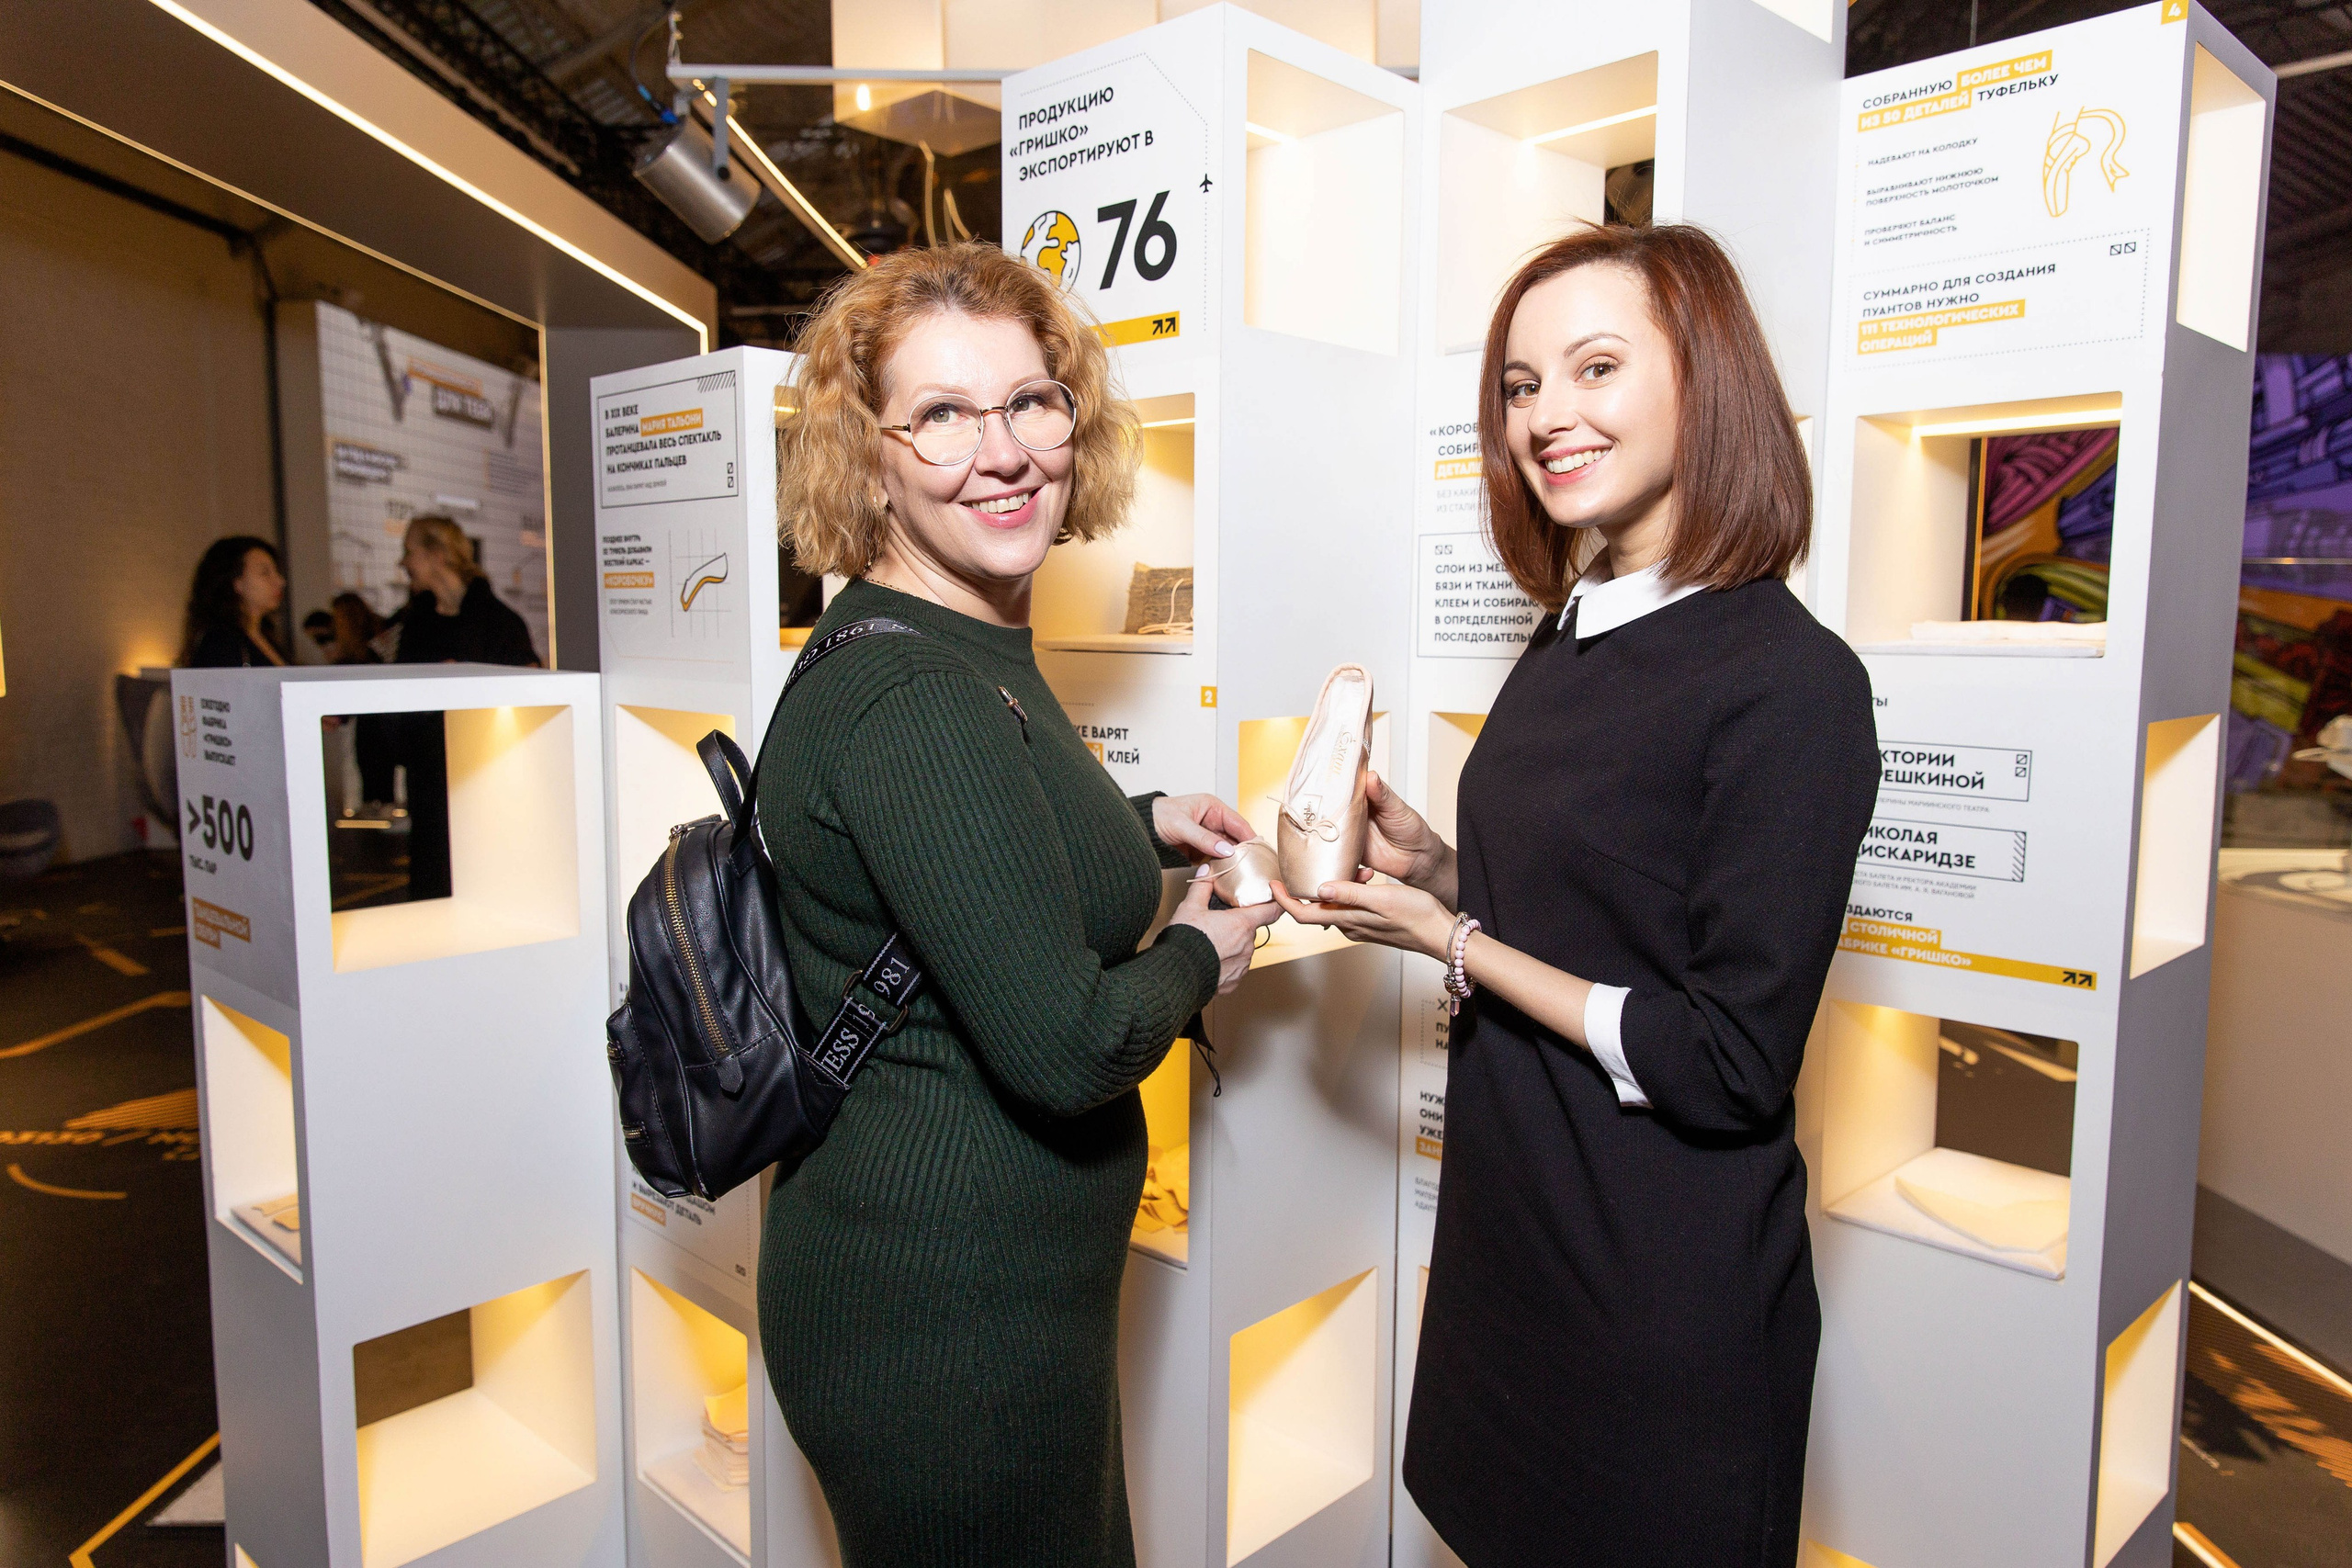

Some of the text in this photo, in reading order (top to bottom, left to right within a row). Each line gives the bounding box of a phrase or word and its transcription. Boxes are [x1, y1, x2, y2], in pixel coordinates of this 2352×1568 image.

[2168, 2, 2181, 17] 4
[1863, 56, 2048, 109] СОБРАННУЮ БОЛЕЕ ЧЕМ
[1019, 86, 1114, 130] ПРОДУКЦИЮ
[1861, 112, 1881, 129] ИЗ
[1904, 90, 1970, 121] ДЕТАЛЕЙ
[1977, 73, 2059, 101] ТУФЕЛЬКУ
[1009, 124, 1089, 158] «ГРИШКО»
[1868, 138, 1978, 166] НАДЕВАЮТ НА КОЛОДКУ
[1019, 130, 1154, 182] ЭКСПОРТИРУЮТ В
[1935, 167, 1984, 183] НИЖНЮЮ
[1866, 175, 1999, 207] ПОВЕРХНОСТЬ МОЛОТОЧКОМ
[1864, 214, 1956, 236] ПРОВЕРЯЮТ БАЛАНС
[1872, 225, 1958, 245] СИММЕТРИЧНОСТЬ
[1097, 189, 1178, 290] 76
[1863, 264, 2056, 301] СУММАРНО ДЛЯ СОЗДАНИЯ
[1862, 292, 1980, 318] ПУАНТОВ НУЖНО
[1881, 304, 2019, 333] ТЕХНОЛОГИЧЕСКИХ
[1860, 331, 1933, 353] ОПЕРАЦИЙ
[659, 436, 677, 448] ВЕСЬ
[678, 431, 722, 446] СПЕКТАКЛЬ
[654, 455, 687, 468] ПАЛЬЦЕВ
[1435, 563, 1465, 574] СЛОИ
[1469, 563, 1483, 573] ИЗ
[1435, 580, 1462, 591] БЯЗИ
[1465, 581, 1473, 591] И
[1476, 580, 1513, 591] ТКАНИ
[1435, 597, 1470, 608] КЛЕЕМ
[1473, 598, 1480, 608] И
[1435, 613, 1533, 626] В ОПРЕДЕЛЕННОЙ
[1204, 690, 1214, 704] 2
[1091, 726, 1129, 740] ВАРЯТ
[1107, 748, 1140, 764] КЛЕЙ
[1858, 844, 1975, 868] ИСКАРИДЗЕ
[1849, 920, 1939, 945] СТОЛИЧНОЙ
[1891, 946, 1972, 967] «ГРИШКО»
[874, 957, 910, 998] 981
